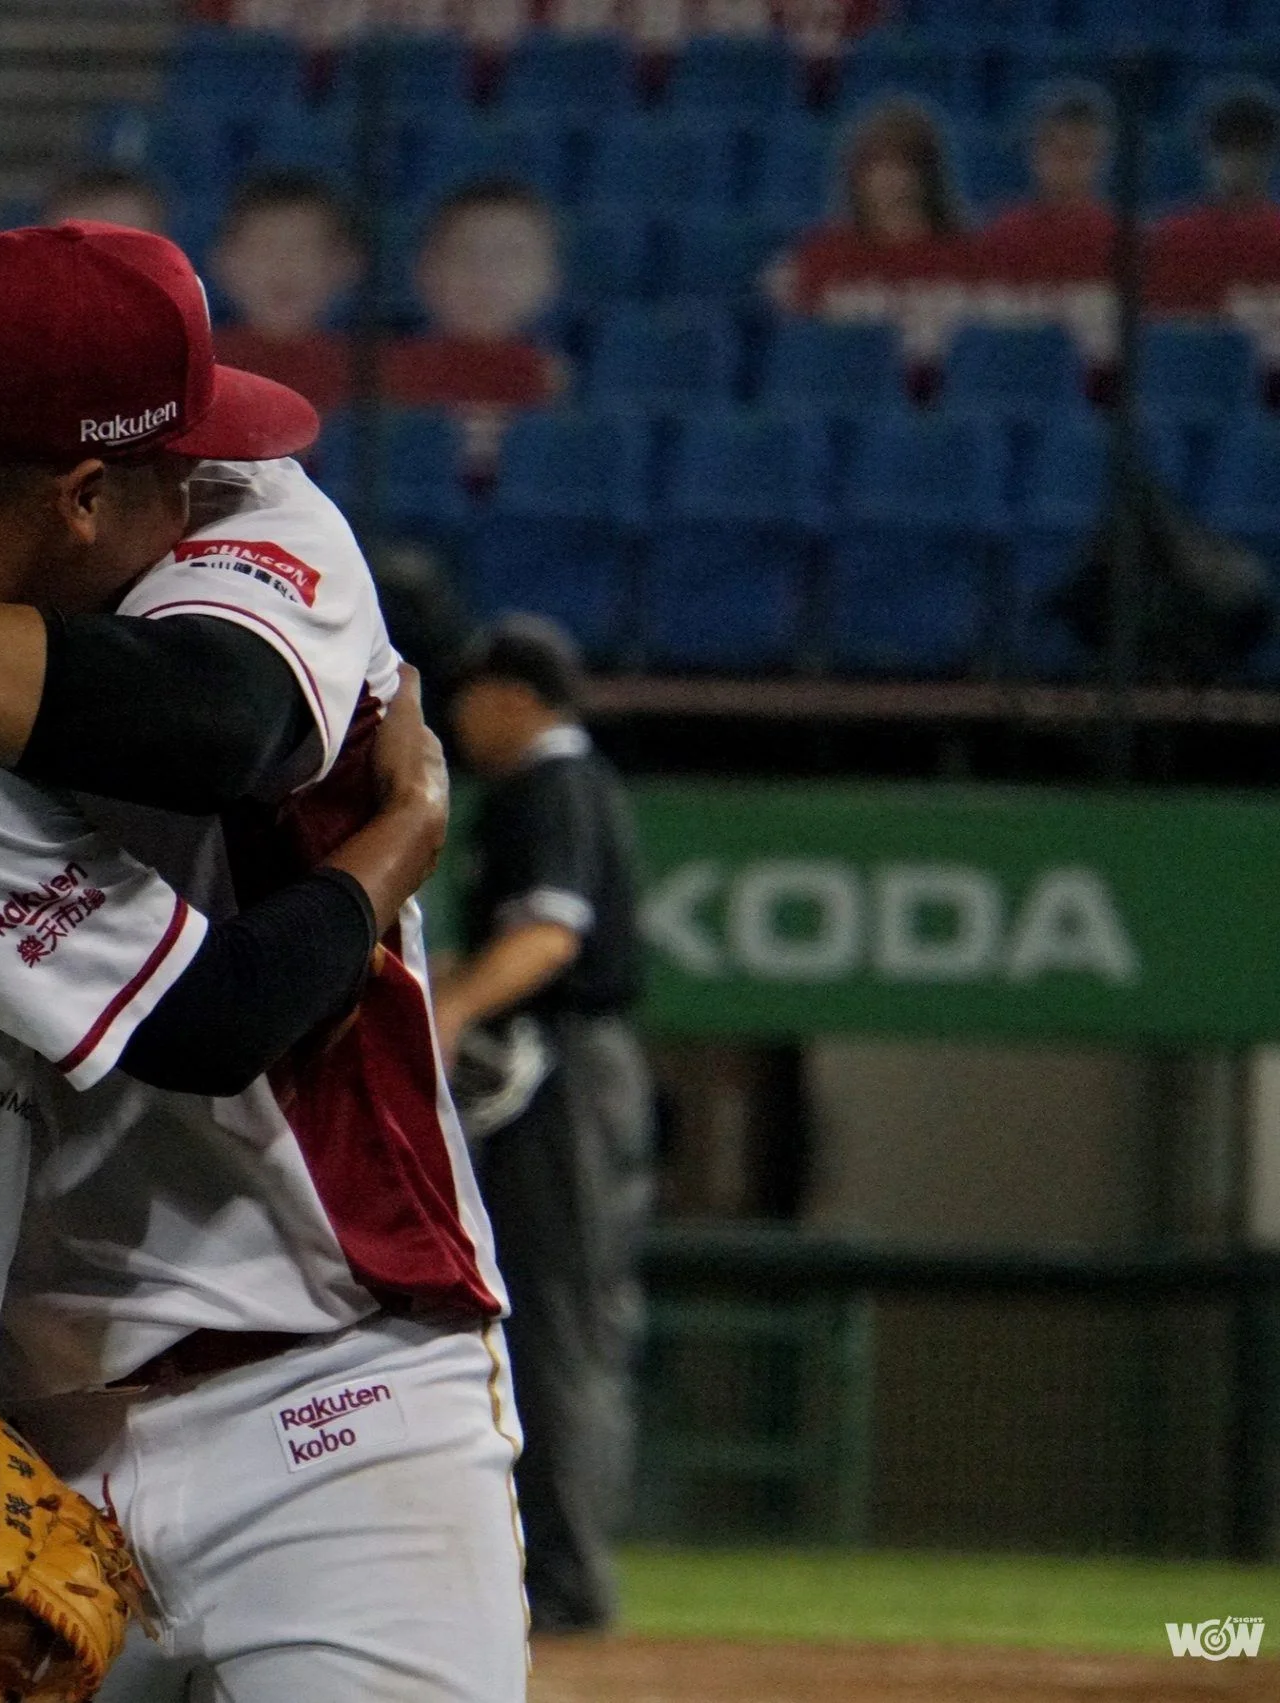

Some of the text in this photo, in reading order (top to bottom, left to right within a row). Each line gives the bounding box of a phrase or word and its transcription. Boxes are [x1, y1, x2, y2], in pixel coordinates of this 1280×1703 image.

[80, 400, 177, 443] Rakuten
[17, 887, 107, 968] 樂天市場
[636, 860, 1139, 984] KODA
[280, 1385, 392, 1430] Rakuten
[288, 1428, 357, 1464] kobo
